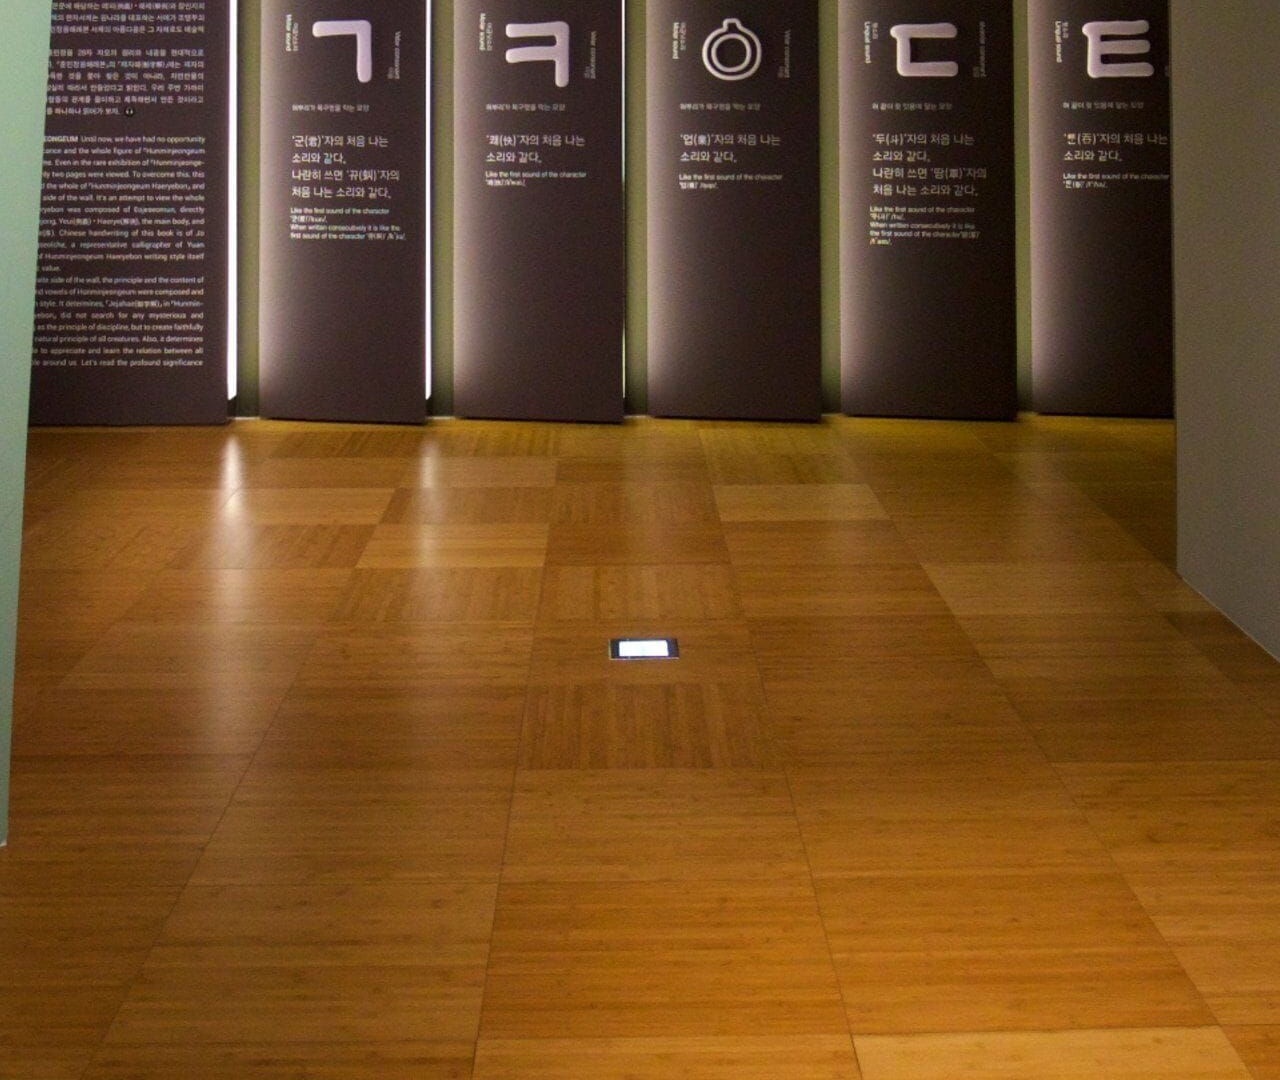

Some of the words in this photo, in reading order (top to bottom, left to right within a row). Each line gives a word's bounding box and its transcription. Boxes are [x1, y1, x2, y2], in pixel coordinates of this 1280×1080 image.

[347, 135, 365, 147] 처음
[368, 135, 388, 147] 나는
[542, 134, 562, 147] 처음
[565, 135, 585, 147] 나는
[737, 134, 756, 146] 처음
[760, 134, 781, 146] 나는
[292, 153, 320, 163] 소리와
[486, 152, 516, 162] 소리와
[680, 151, 710, 162] 소리와
[873, 151, 903, 161] 소리와
[1064, 151, 1095, 161] 소리와
[292, 186, 310, 198] 처음
[313, 186, 333, 198] 나는
[336, 187, 365, 198] 소리와
[920, 184, 951, 195] 소리와
